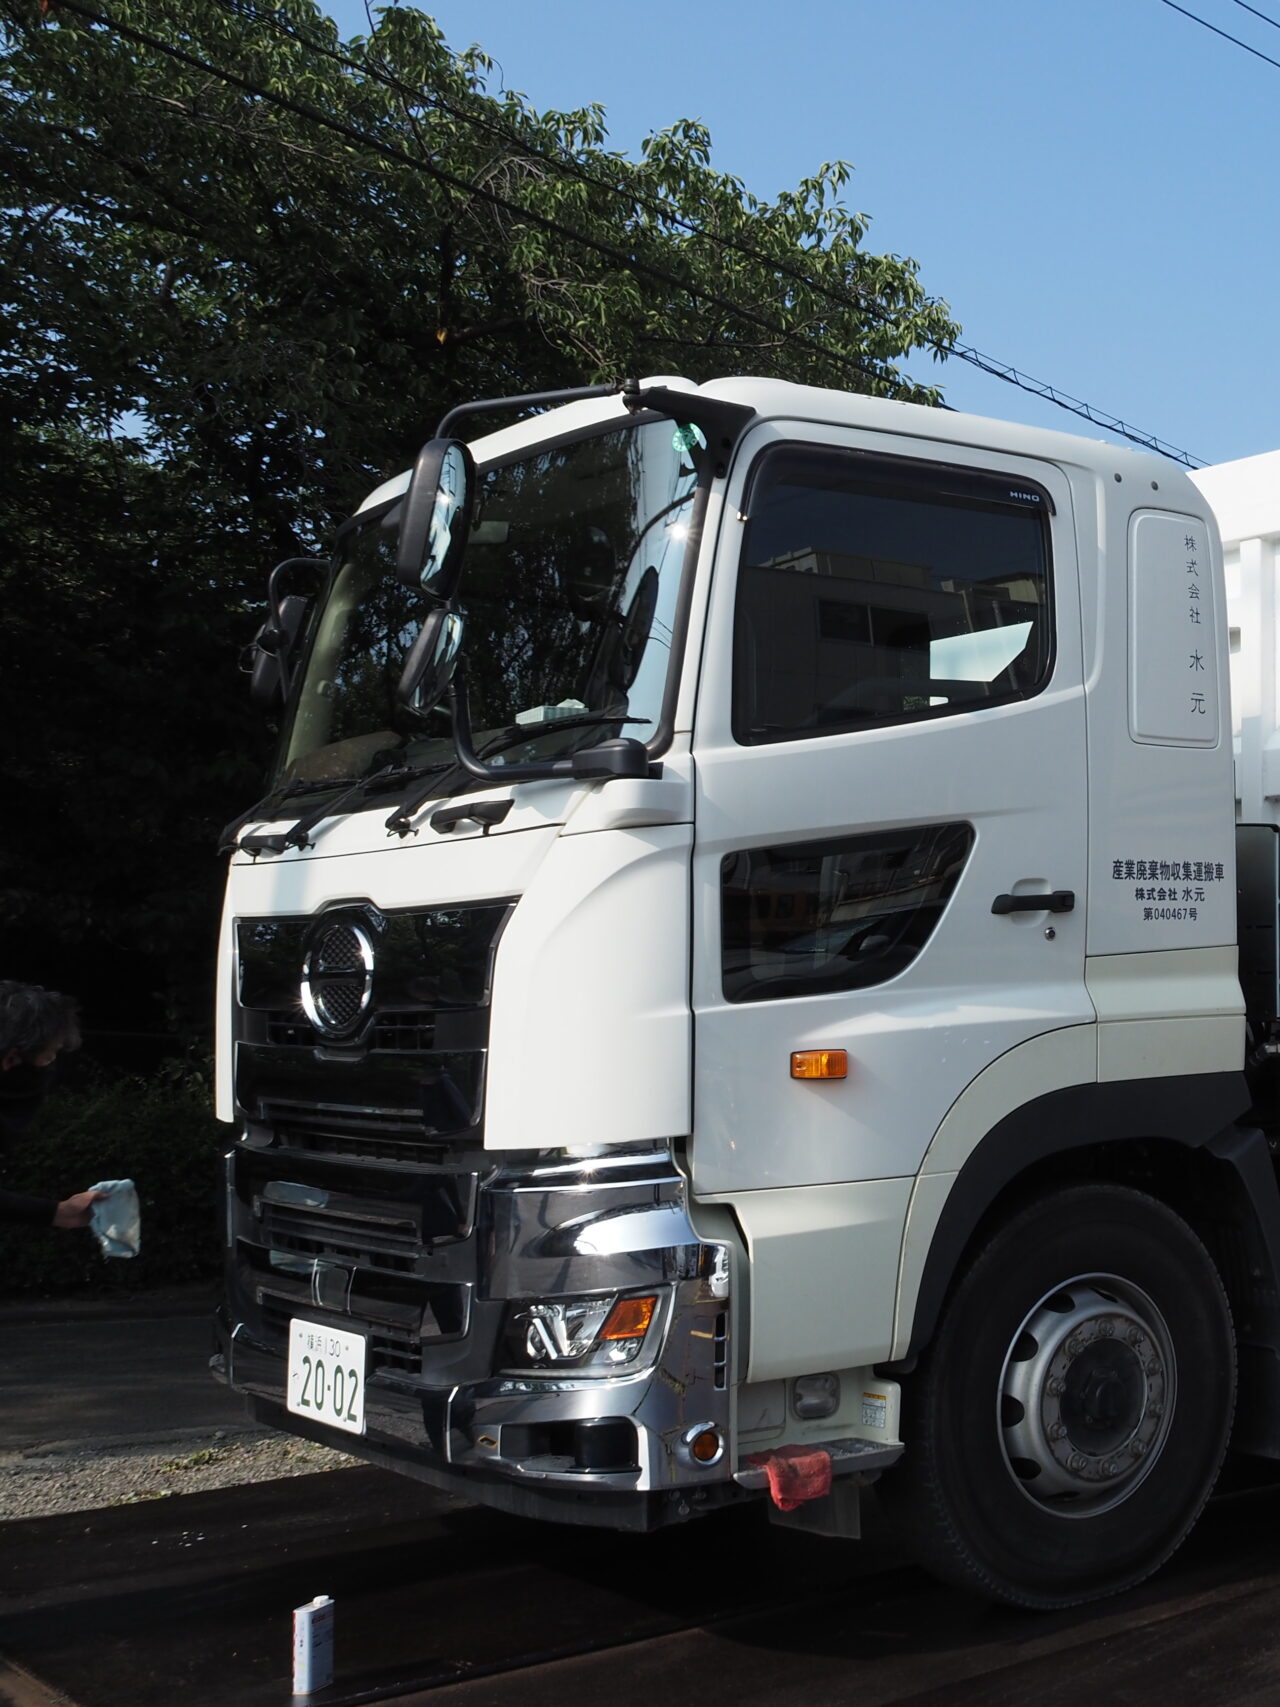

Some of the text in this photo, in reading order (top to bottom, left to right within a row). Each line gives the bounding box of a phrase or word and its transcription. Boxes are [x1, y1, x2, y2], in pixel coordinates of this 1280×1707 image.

[1010, 491, 1040, 502] HINO
[1184, 534, 1206, 715] 株式会社 水元
[1112, 859, 1225, 882] 産業廃棄物収集運搬車
[1135, 886, 1205, 902] 株式会社 水元
[1143, 907, 1198, 921] 第040467号
